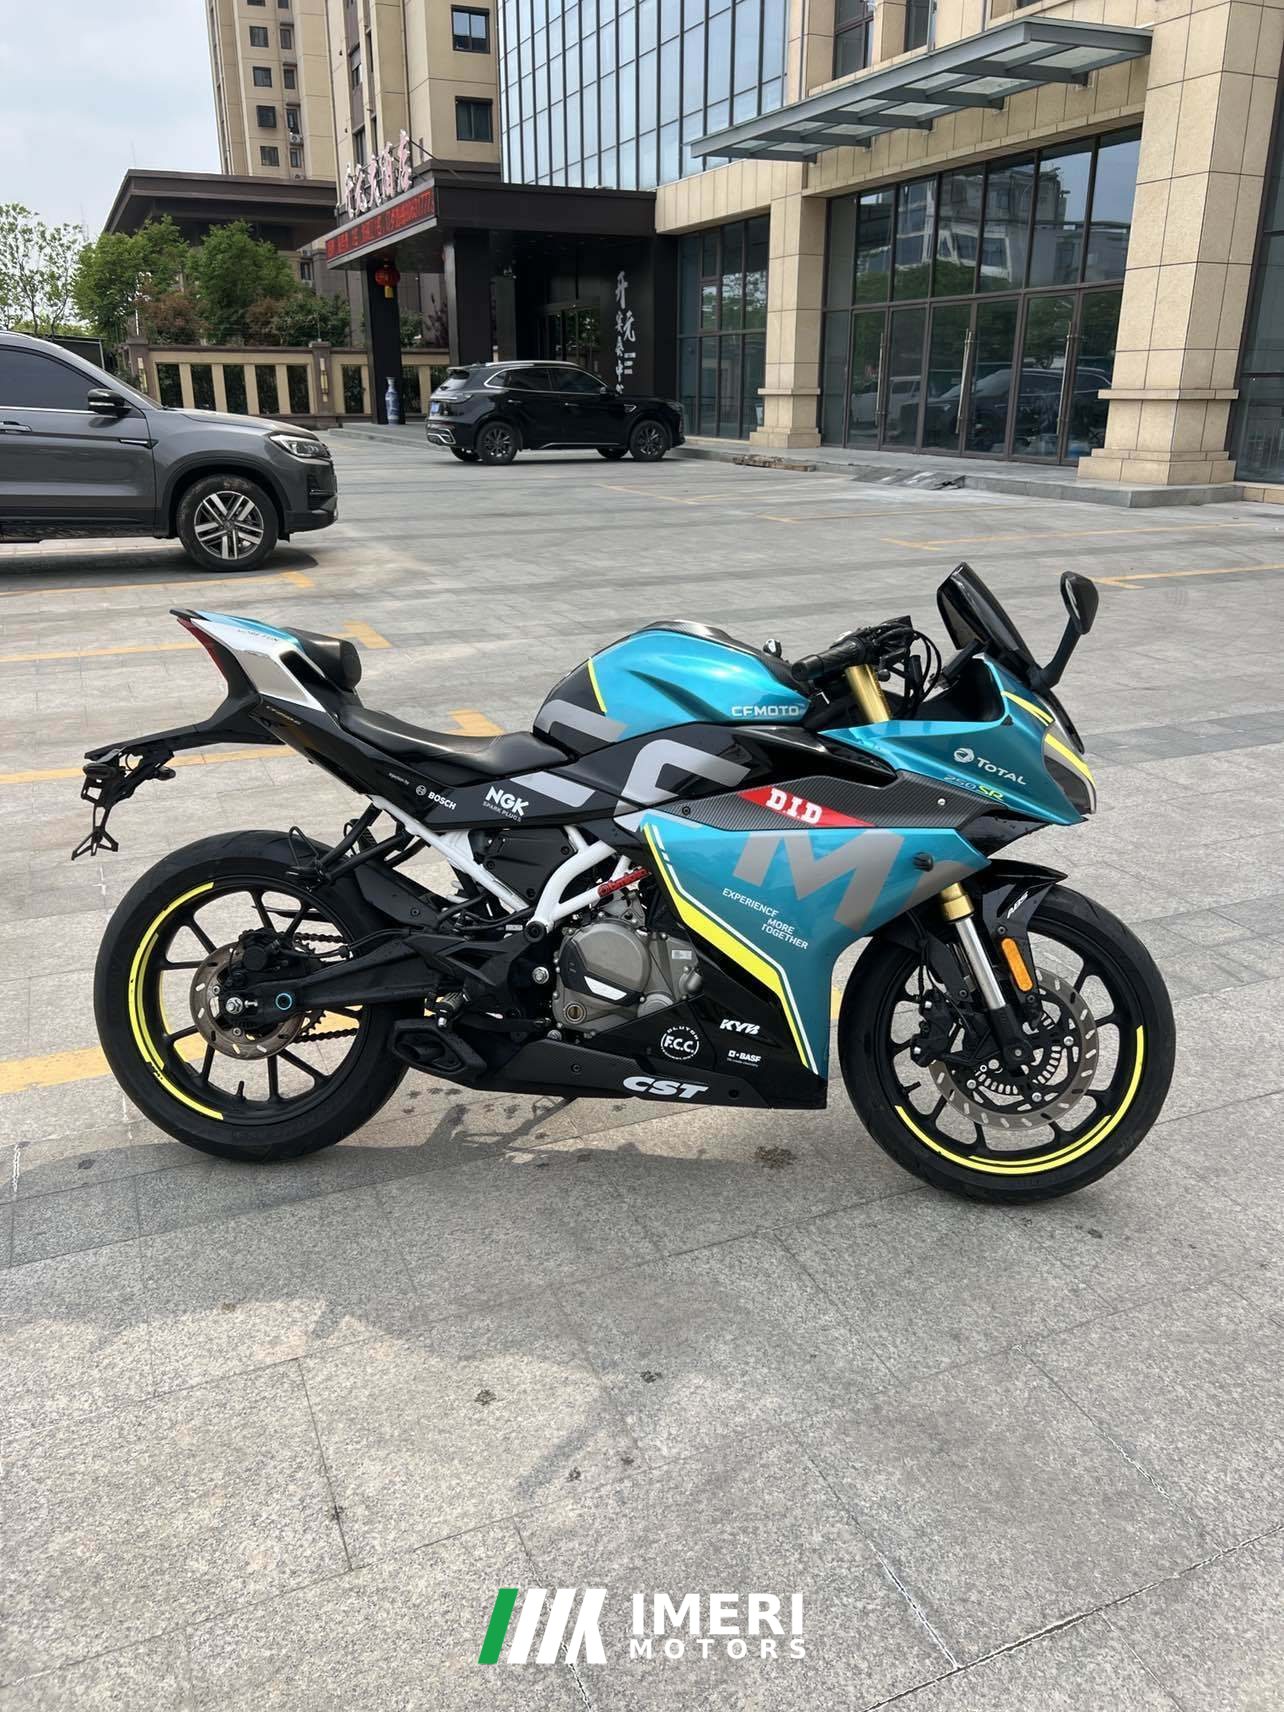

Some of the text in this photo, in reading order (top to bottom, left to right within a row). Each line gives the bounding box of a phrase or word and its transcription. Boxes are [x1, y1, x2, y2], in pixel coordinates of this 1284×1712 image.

[731, 705, 800, 717] CFMOTO
[976, 756, 1027, 785] TOTAL
[428, 791, 457, 810] BOSCH
[482, 801, 501, 814] SPARK
[485, 786, 529, 816] NGK
[722, 887, 779, 917] EXPERIENCE
[767, 918, 795, 935] MORE
[761, 924, 809, 950] TOGETHER
[719, 1019, 761, 1035] KYB
[664, 1035, 694, 1053] F.C.C.
[739, 1053, 762, 1063] BASF
[623, 1076, 709, 1099] CST
